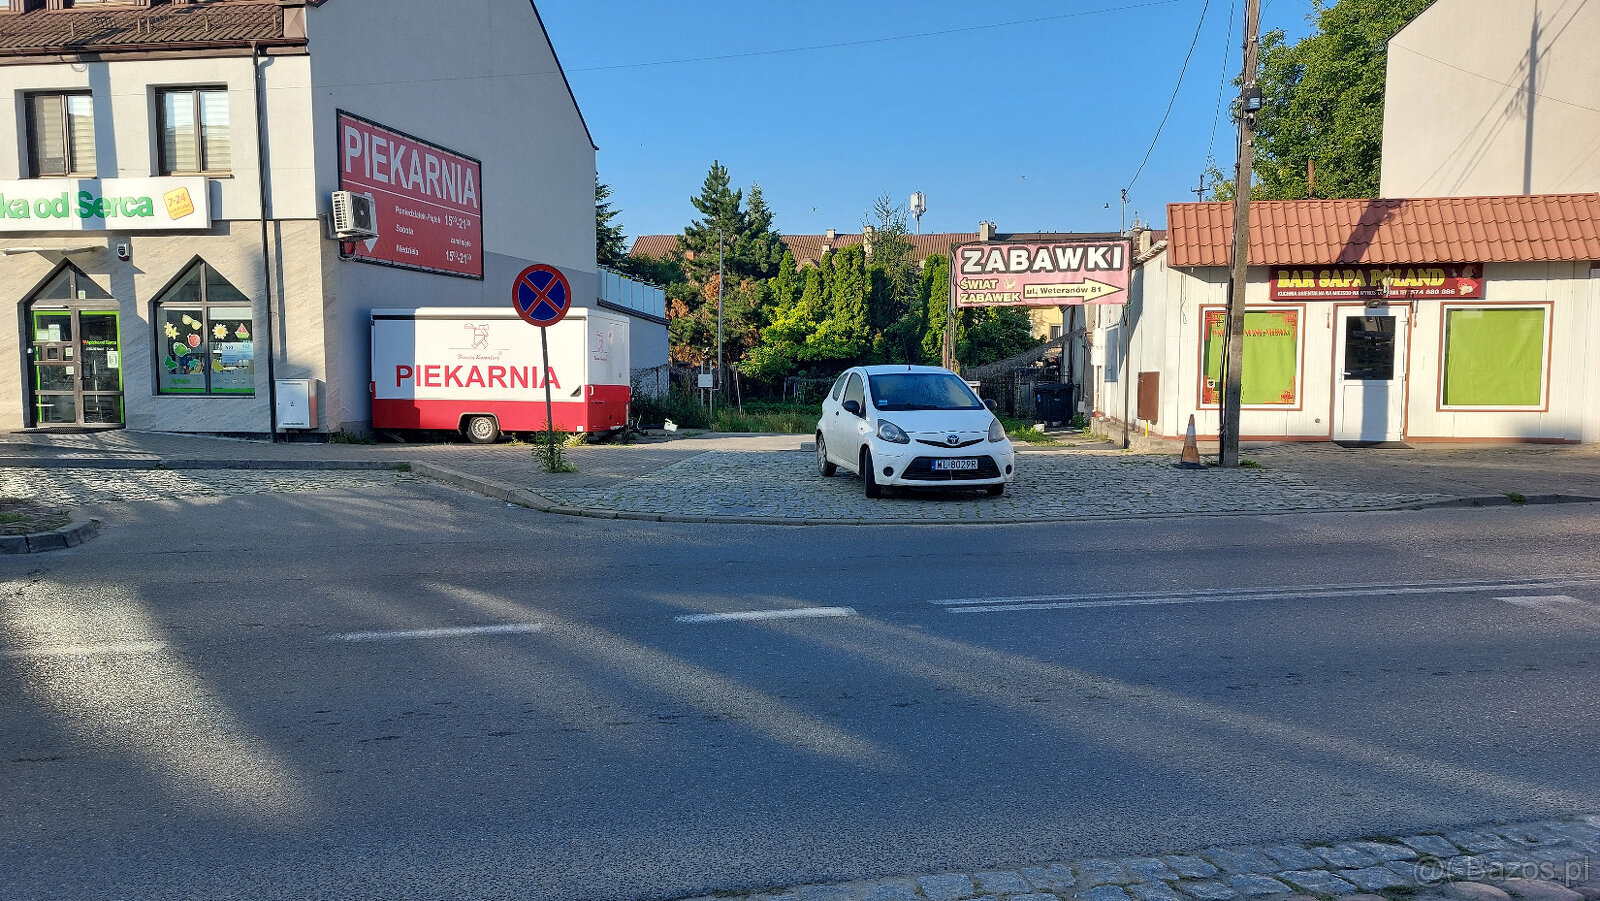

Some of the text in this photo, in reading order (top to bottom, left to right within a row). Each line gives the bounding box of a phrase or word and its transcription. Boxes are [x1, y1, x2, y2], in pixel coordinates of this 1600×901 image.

[344, 125, 478, 209] PIEKARNIA
[33, 192, 69, 219] od
[74, 191, 154, 218] Serca
[168, 193, 186, 207] 7-24
[395, 224, 414, 236] Sobota
[396, 244, 419, 256] Niedziela
[961, 244, 1123, 274] ZABAWKI
[960, 276, 999, 291] ŚWIAT
[1277, 268, 1446, 288] BAR SAPA POLAND
[1040, 285, 1088, 295] Weteranów
[960, 291, 1021, 304] ZABAWEK
[396, 364, 561, 389] PIEKARNIA
[937, 460, 976, 469] WL 8029R
